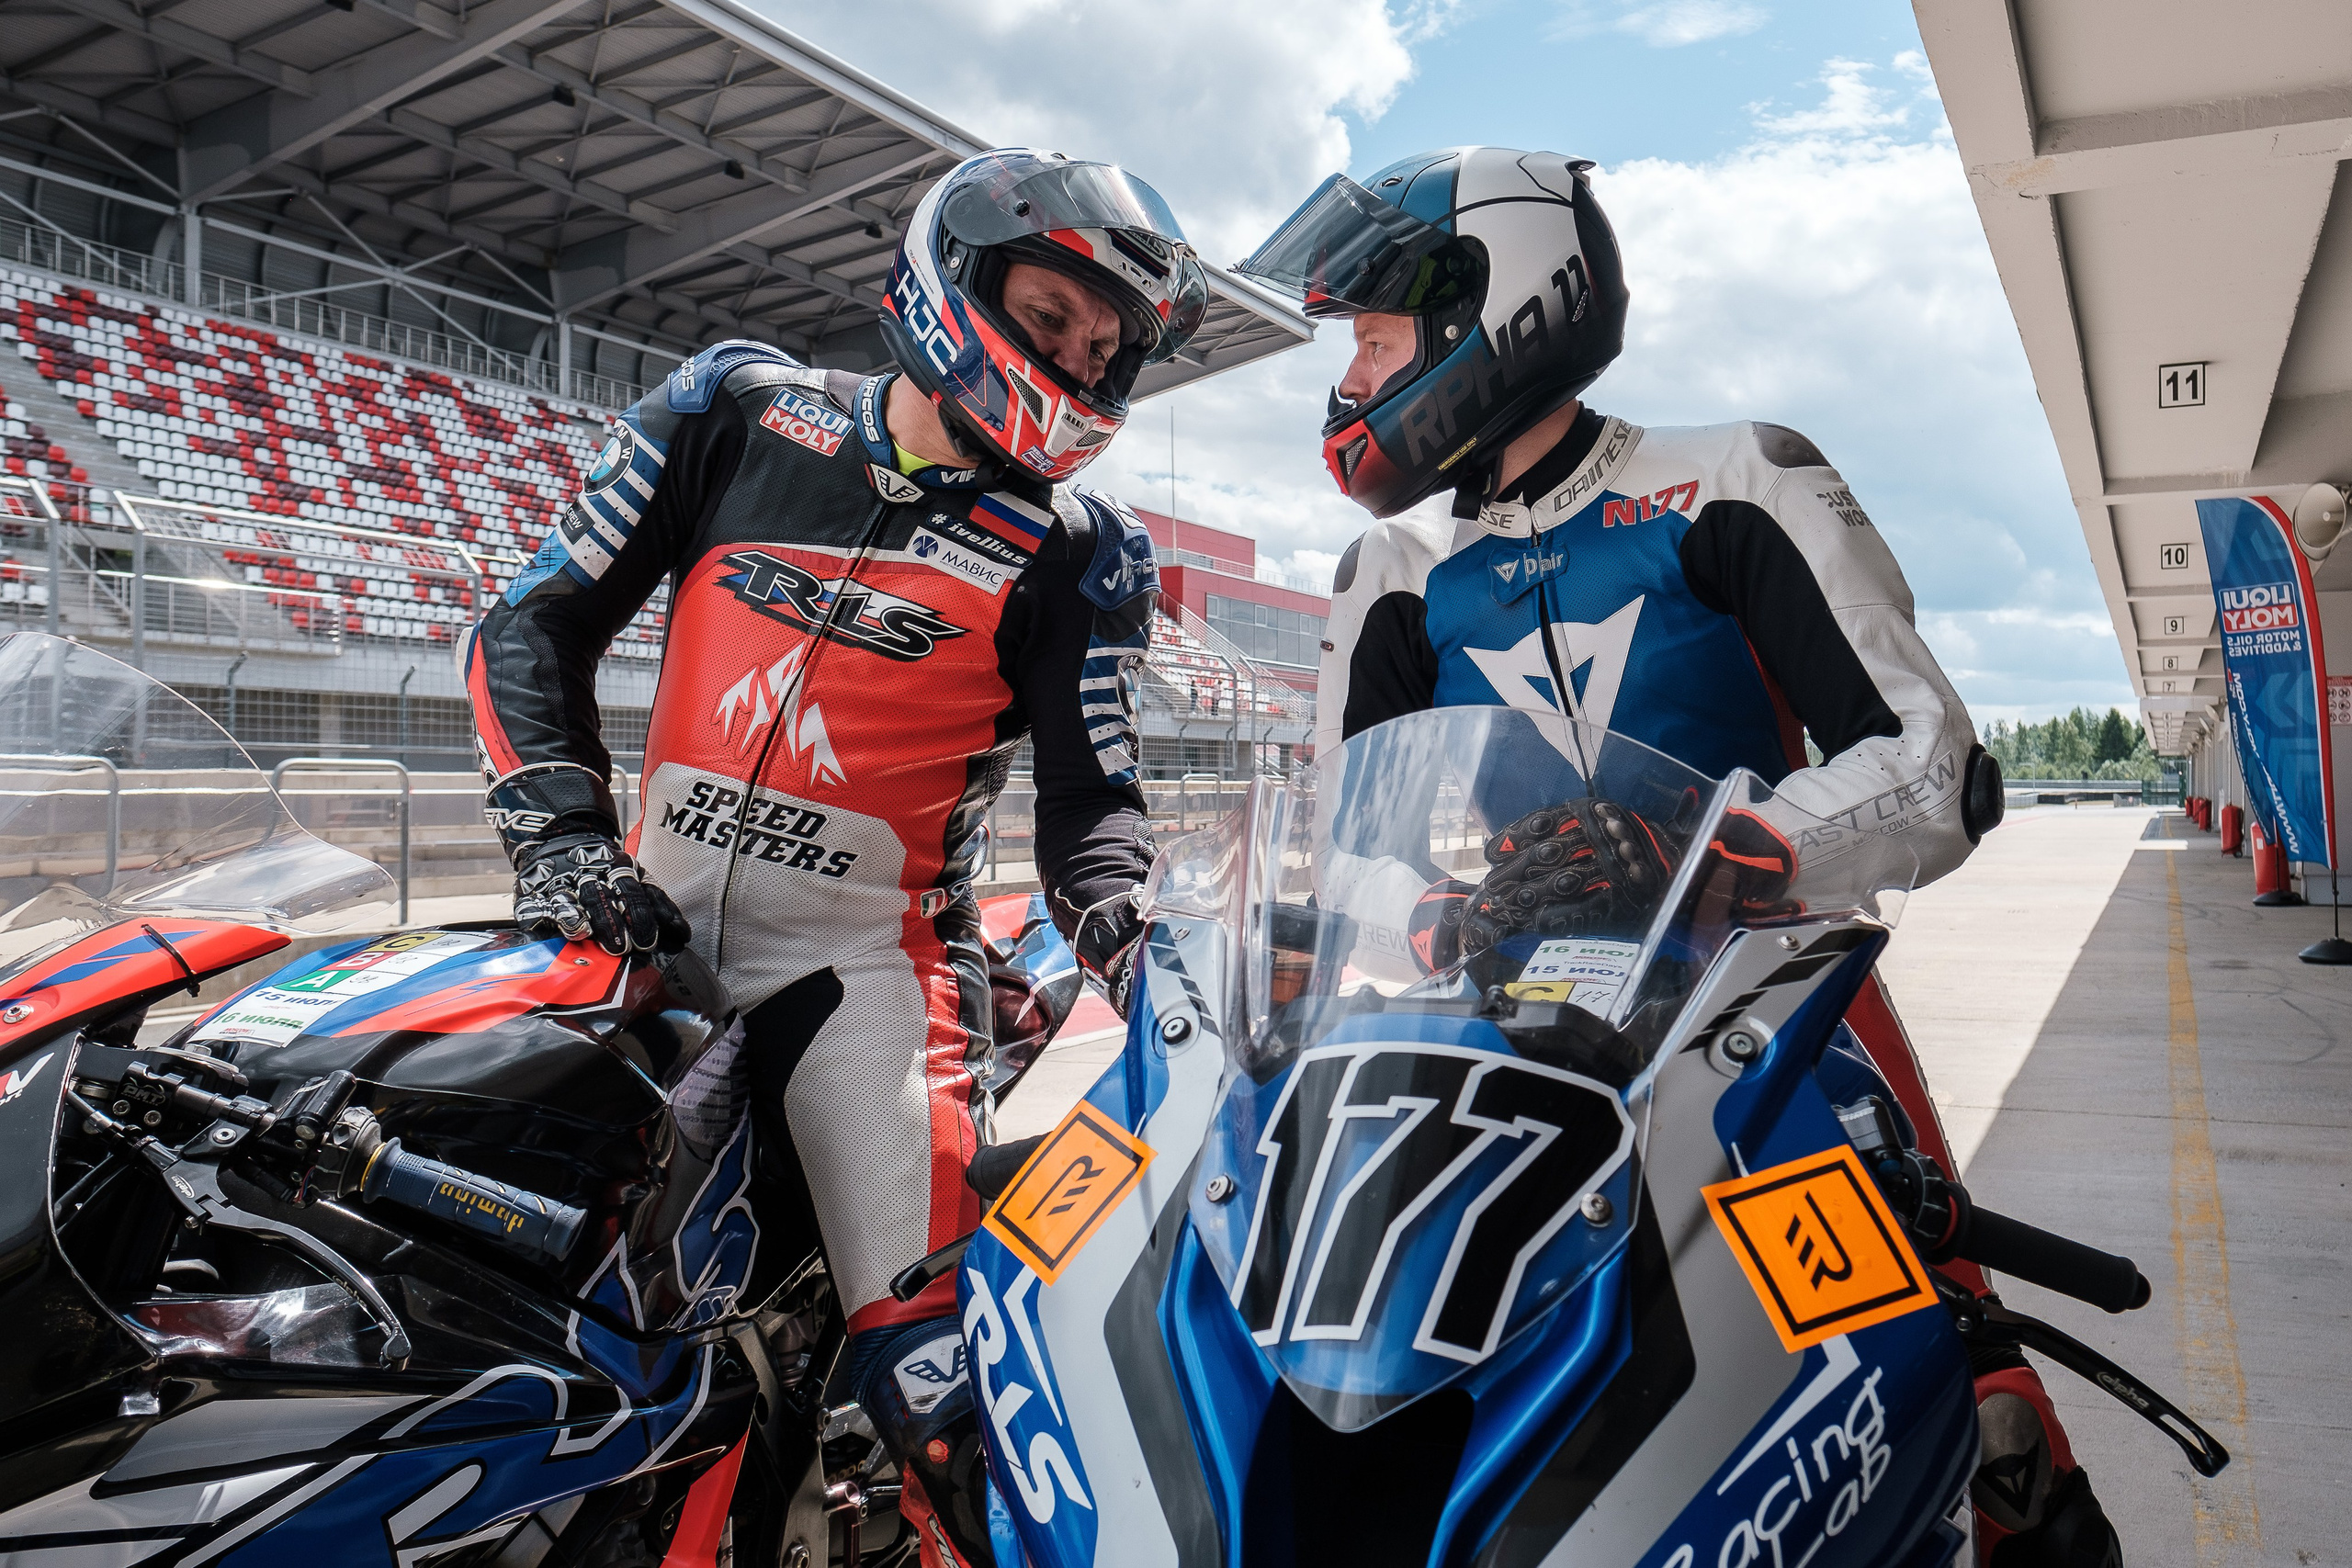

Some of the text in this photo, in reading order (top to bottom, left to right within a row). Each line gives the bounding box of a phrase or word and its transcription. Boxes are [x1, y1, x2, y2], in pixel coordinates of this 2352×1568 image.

[896, 269, 957, 376] HJC
[1399, 254, 1589, 467] RPHA 11
[2165, 369, 2199, 402] 11
[765, 408, 842, 452] MOLY
[775, 392, 851, 434] LIQUI
[1554, 418, 1634, 513] DAINESE
[1603, 479, 1701, 528] N177
[941, 550, 1003, 586] МАВИС
[2164, 547, 2185, 566] 10
[2170, 619, 2178, 632] 9
[2167, 659, 2174, 669] 8
[685, 780, 830, 841] SPEED
[1792, 750, 1956, 856] AST CREW
[659, 799, 862, 880] MASTERS
[335, 952, 384, 967] B
[383, 936, 425, 949] C
[1539, 945, 1572, 954] 16
[293, 970, 335, 988] A
[1527, 965, 1560, 975] 15
[1232, 1040, 1637, 1366] 177
[2101, 1374, 2150, 1410] alpha
[1651, 1365, 1886, 1568] acing
